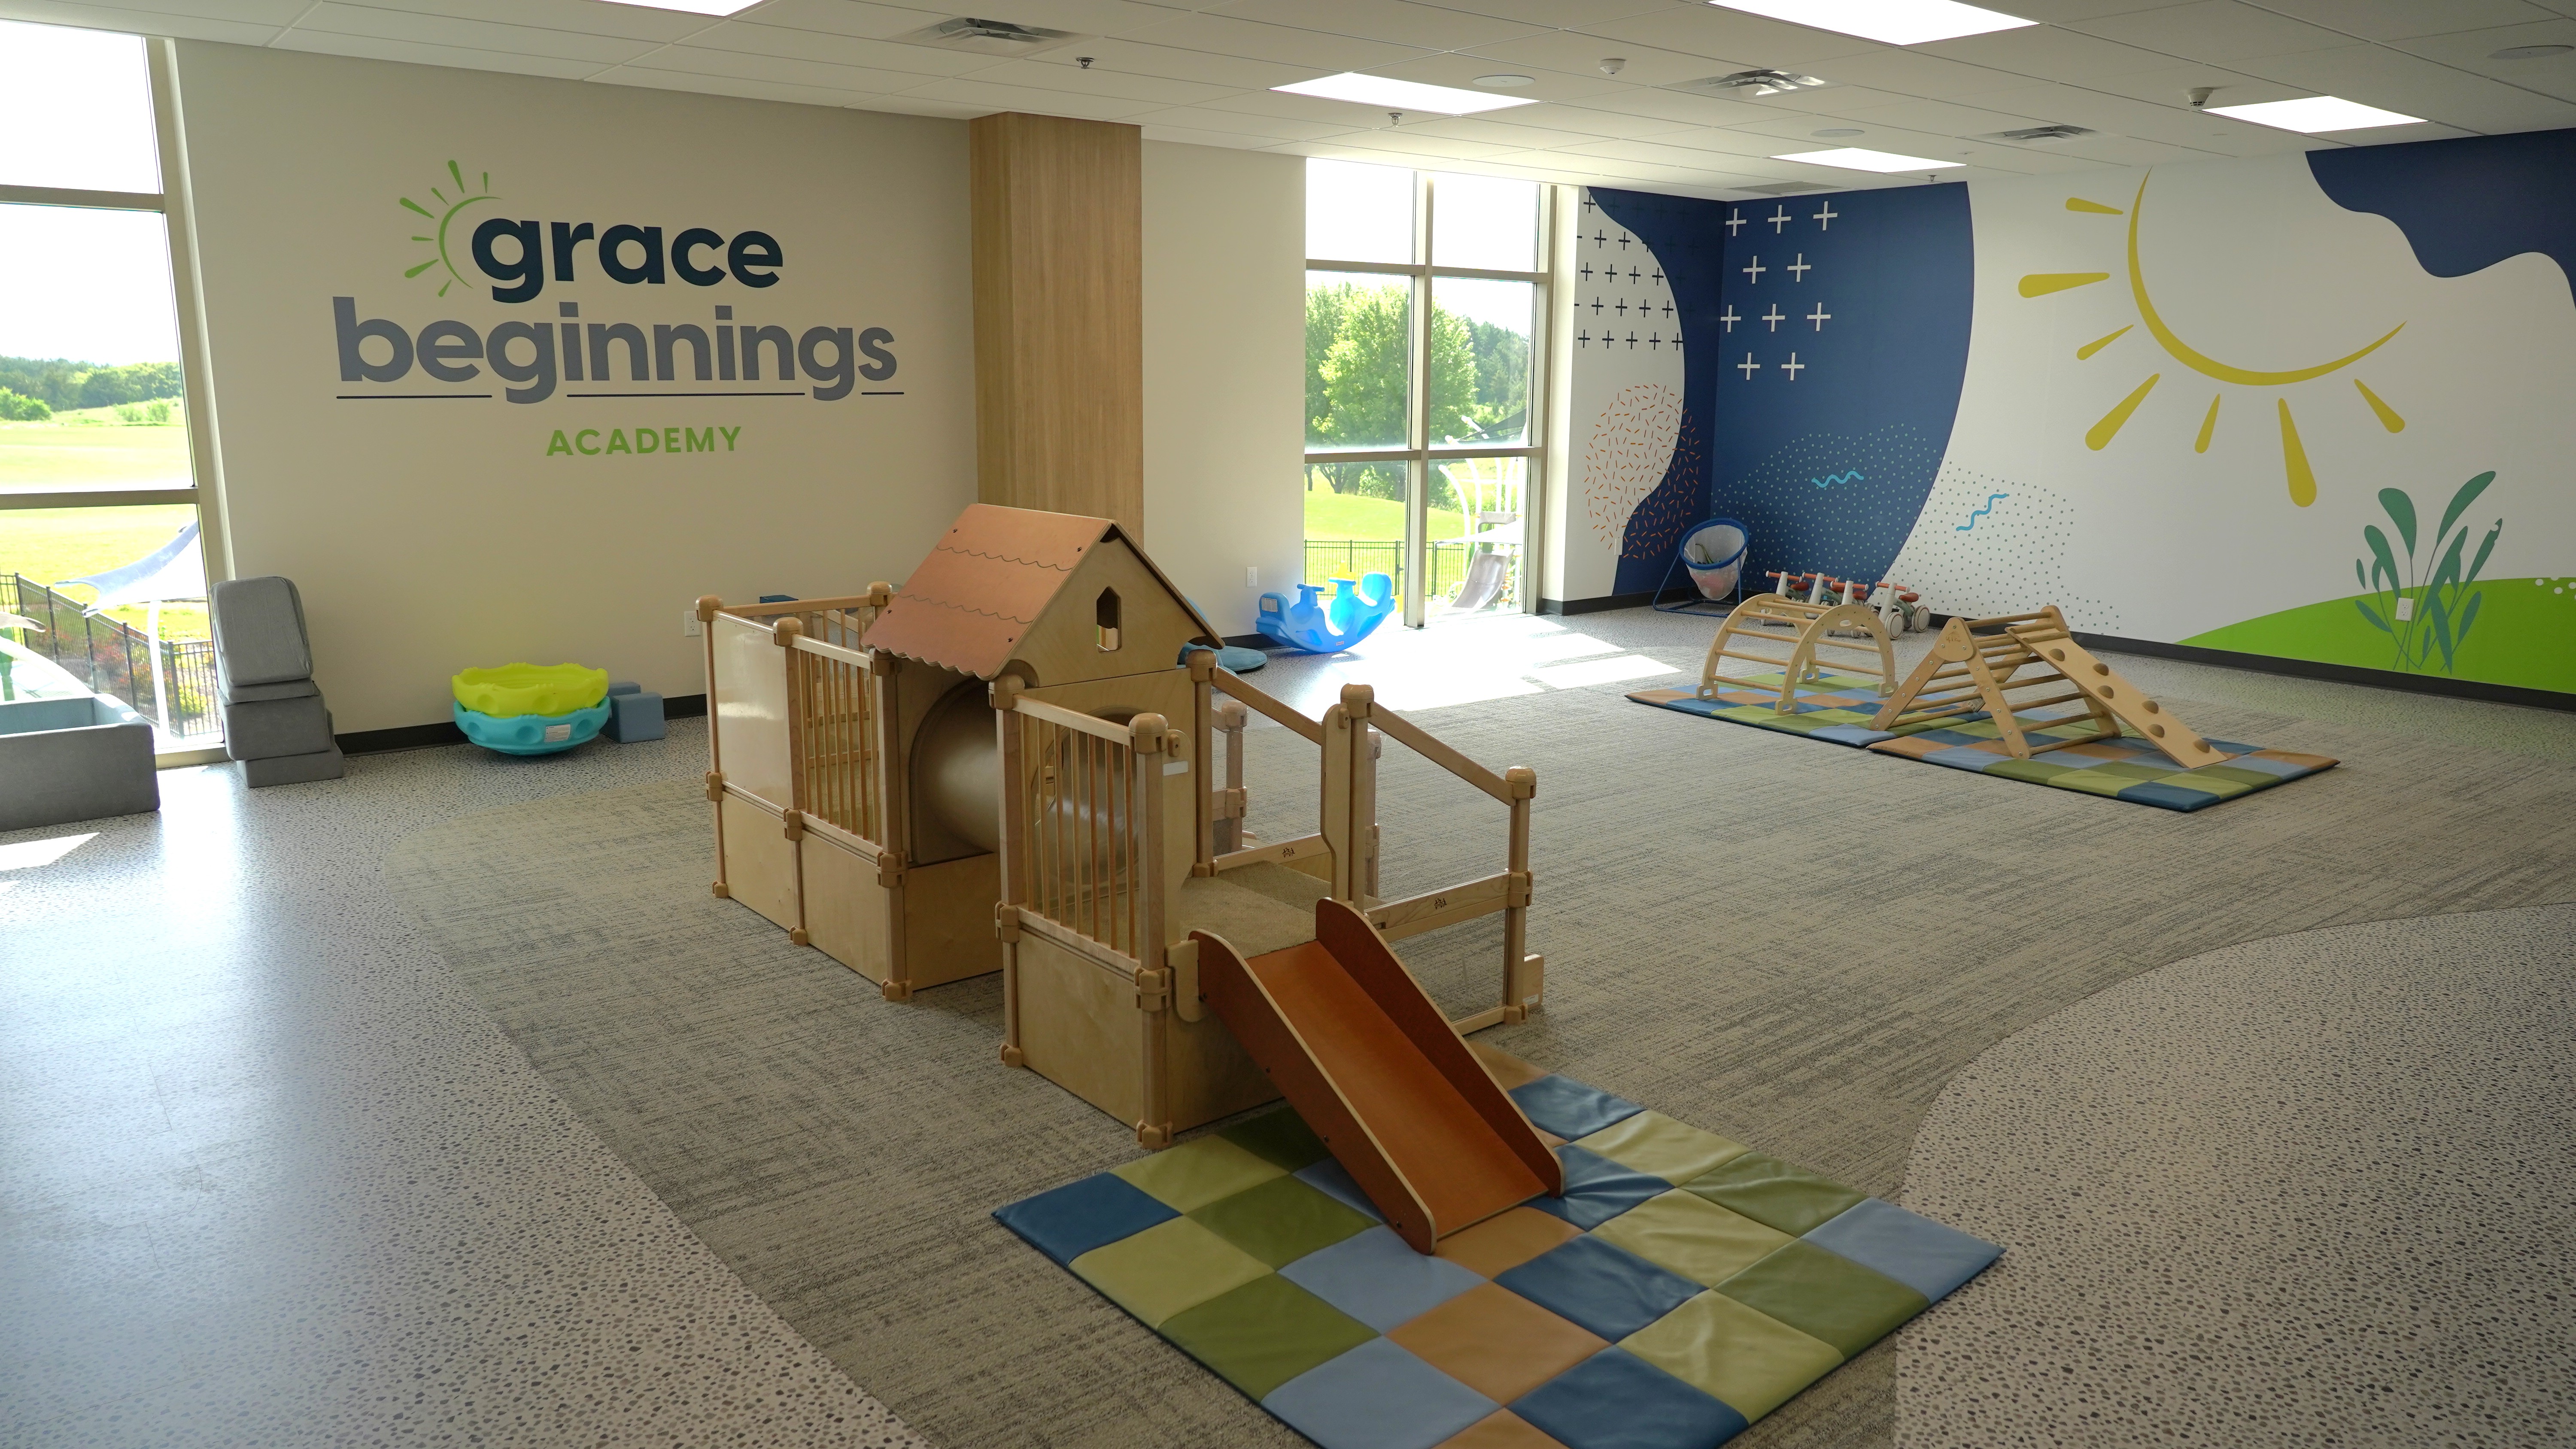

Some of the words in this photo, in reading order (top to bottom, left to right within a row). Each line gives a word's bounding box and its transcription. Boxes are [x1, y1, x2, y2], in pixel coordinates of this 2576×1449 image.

[471, 218, 784, 303] grace
[333, 296, 897, 404] beginnings
[546, 426, 742, 456] ACADEMY
